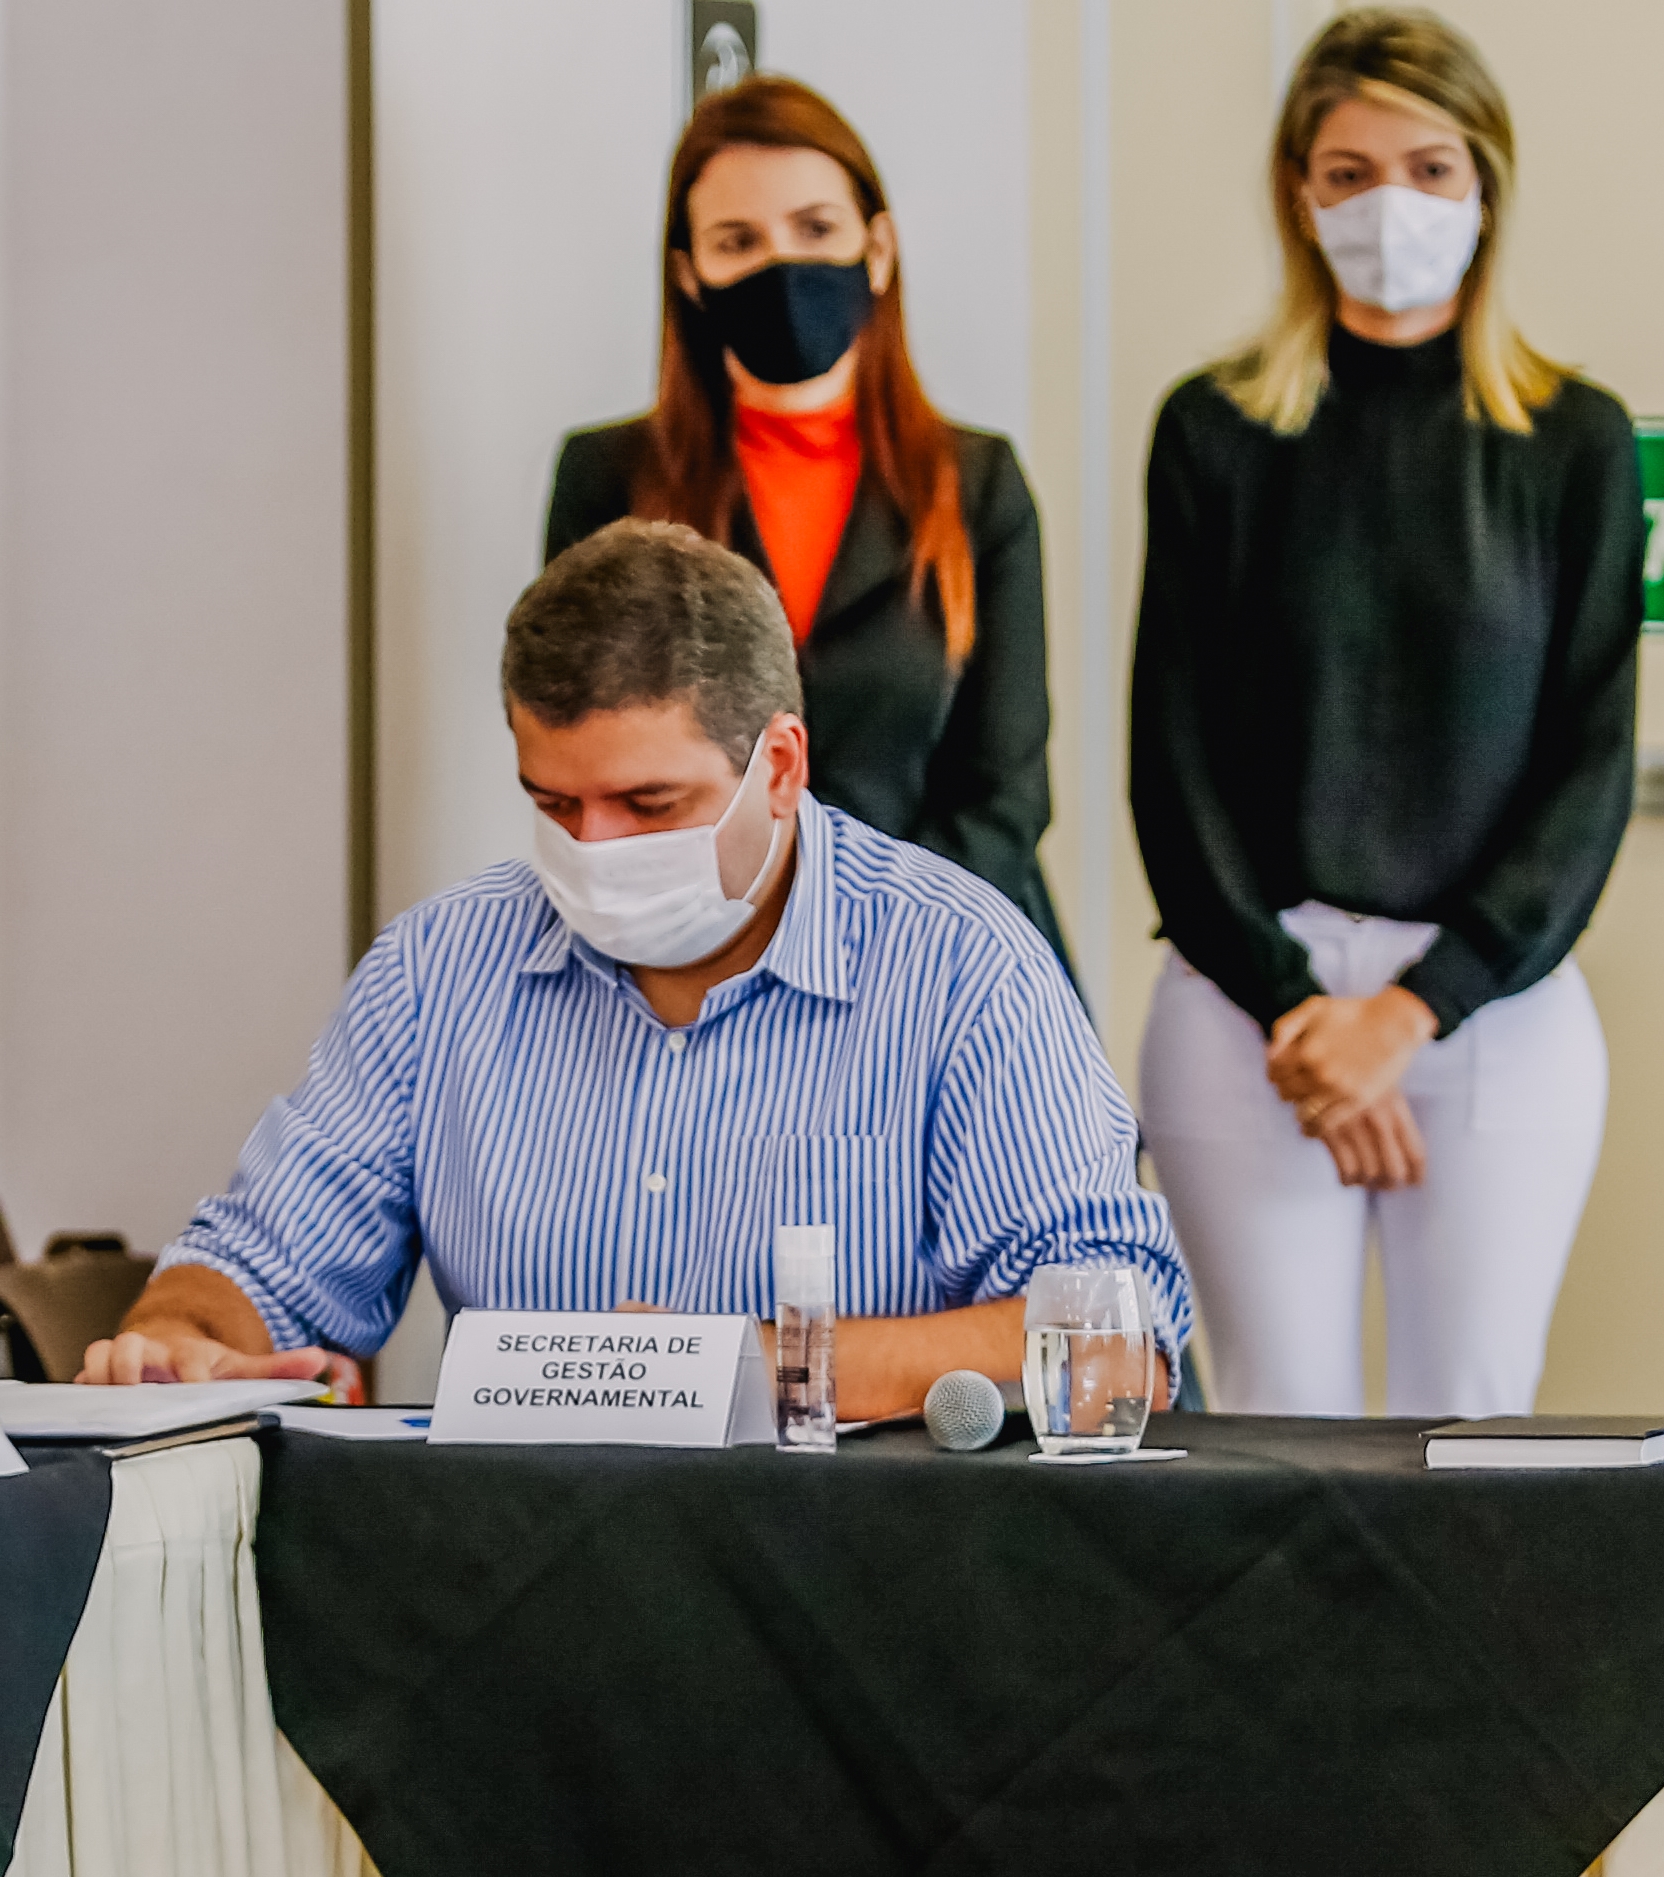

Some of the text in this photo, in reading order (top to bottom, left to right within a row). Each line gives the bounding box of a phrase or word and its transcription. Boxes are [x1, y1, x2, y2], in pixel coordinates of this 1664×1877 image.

[497, 1334, 702, 1354] SECRETARIA DE
[542, 1358, 646, 1380] GESTÃO
[473, 1387, 704, 1408] GOVERNAMENTAL
